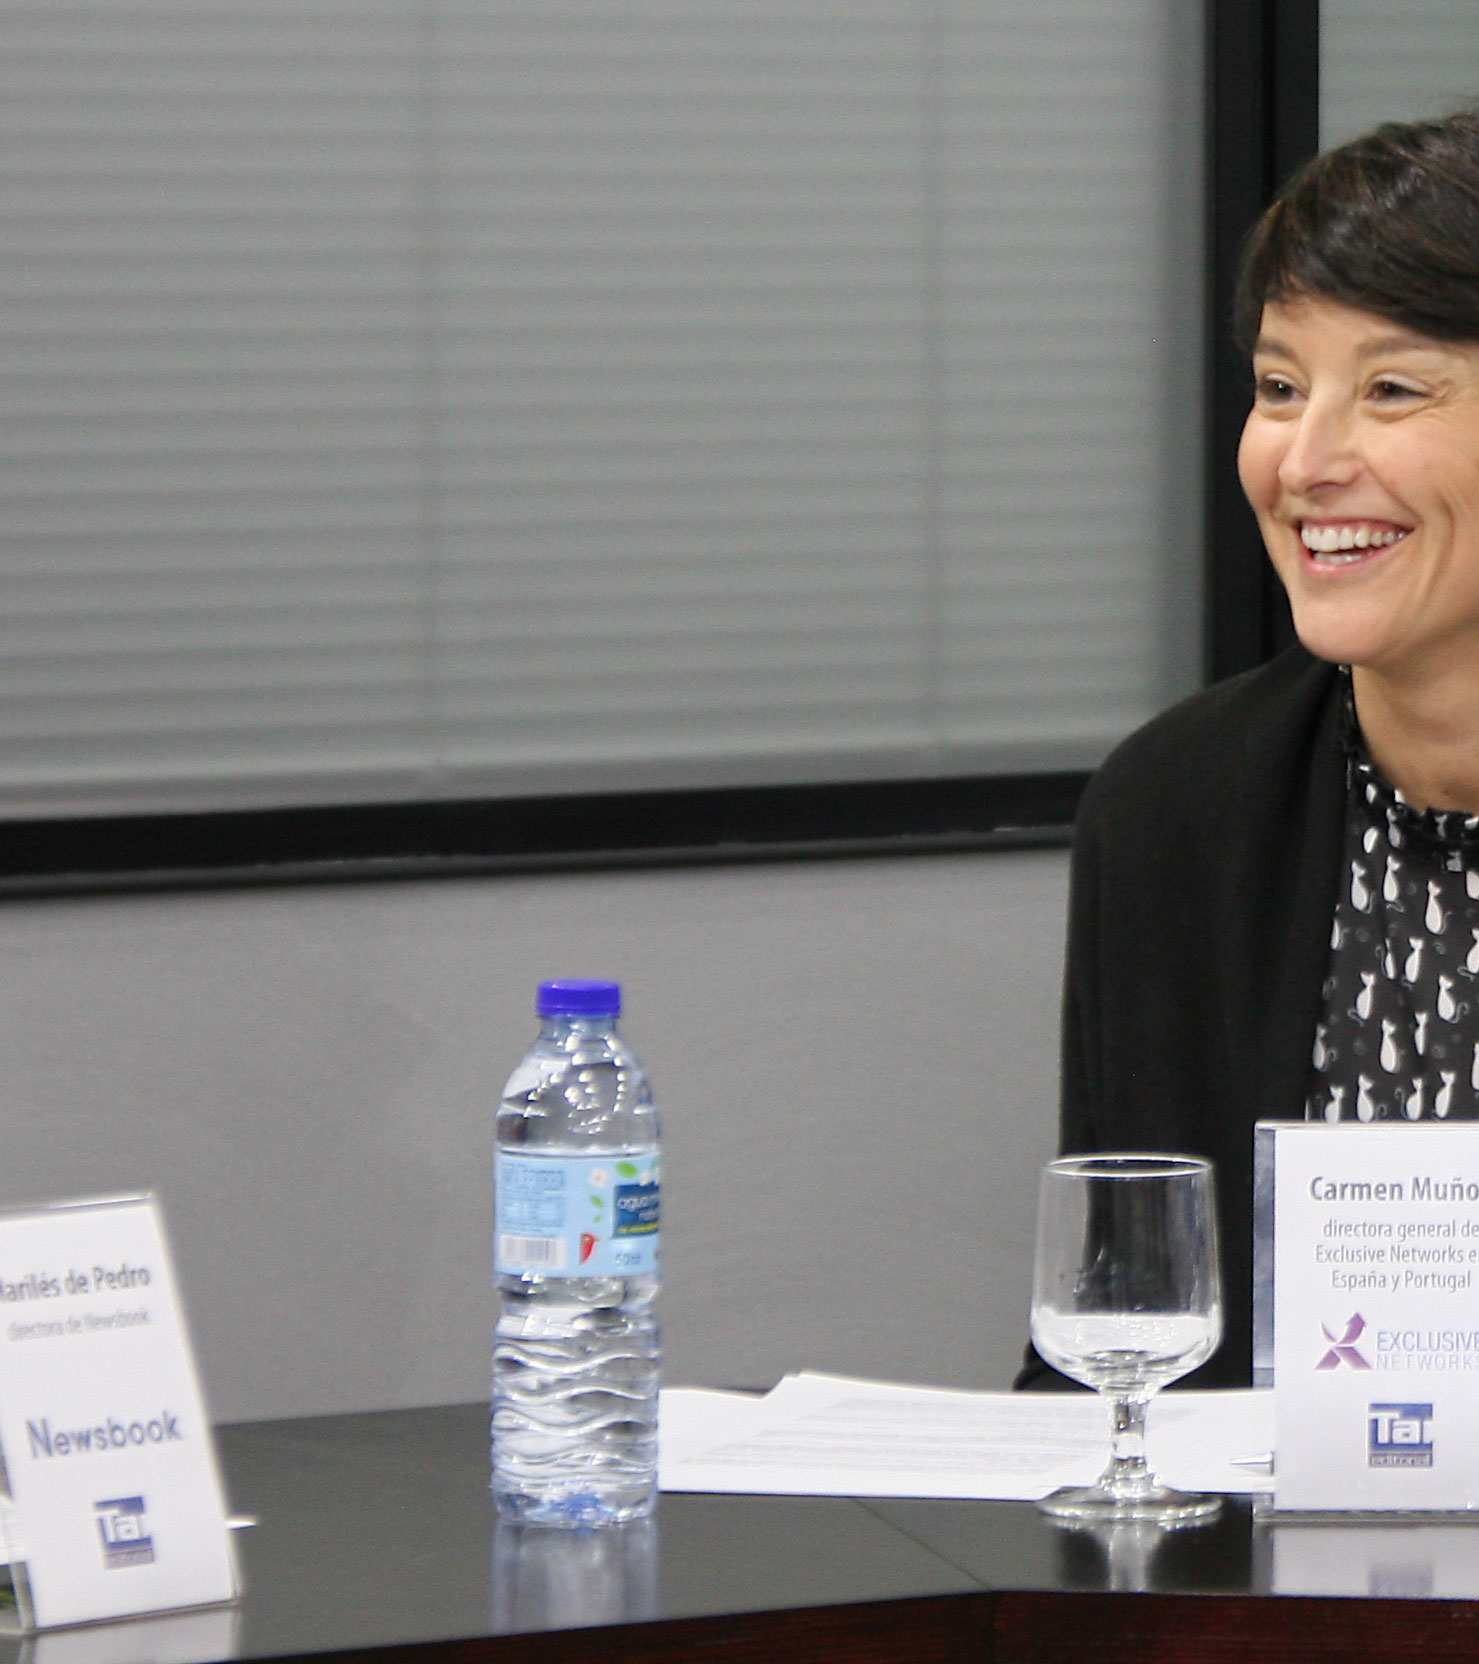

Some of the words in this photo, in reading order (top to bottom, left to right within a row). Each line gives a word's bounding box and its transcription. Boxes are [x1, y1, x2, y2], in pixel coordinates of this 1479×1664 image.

[1309, 1176, 1404, 1201] Carmen
[1323, 1219, 1392, 1237] directora
[1397, 1219, 1456, 1242] general
[1460, 1219, 1479, 1238] de
[1316, 1244, 1386, 1263] Exclusive
[1390, 1244, 1464, 1263] Networks
[0, 1272, 61, 1303] arilés
[64, 1268, 89, 1296] de
[92, 1262, 151, 1293] Pedro
[1332, 1270, 1386, 1291] España
[1390, 1274, 1400, 1292] y
[1404, 1270, 1471, 1293] Portugal
[26, 1409, 183, 1460] Newsbook
